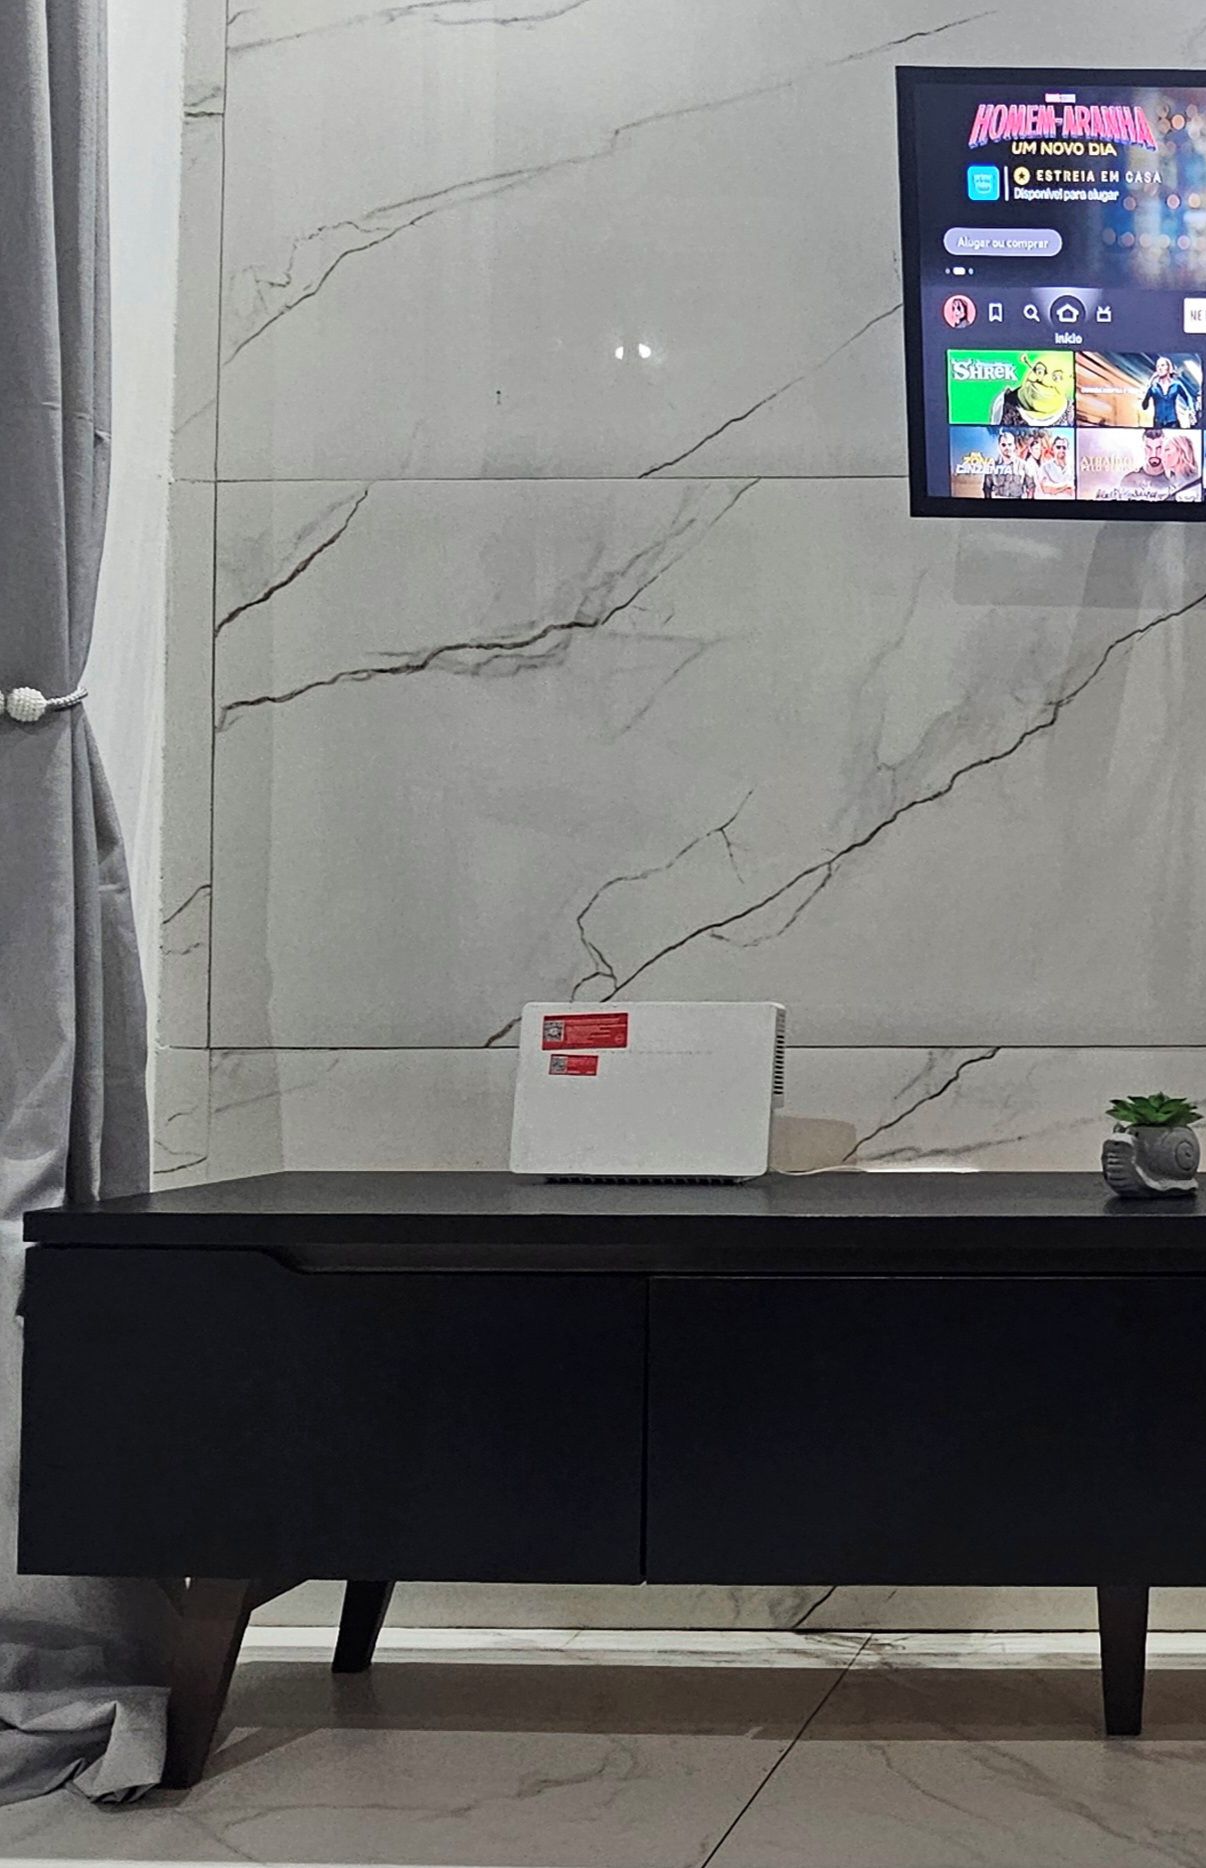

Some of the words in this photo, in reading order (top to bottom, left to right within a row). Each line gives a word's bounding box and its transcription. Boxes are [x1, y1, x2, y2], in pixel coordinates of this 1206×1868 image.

[968, 104, 1158, 151] HOMEM-ARANHA
[1012, 141, 1035, 155] UM
[1041, 142, 1085, 156] NOVO
[1088, 143, 1118, 156] DIA
[1036, 169, 1096, 182] ESTREIA
[1101, 170, 1120, 182] EM
[1125, 170, 1162, 184] CASA
[1013, 187, 1063, 200] Disponível
[1063, 190, 1087, 201] para
[1087, 188, 1120, 202] alugar
[957, 236, 990, 250] Alugar
[991, 239, 1005, 248] ou
[1006, 239, 1050, 251] comprar
[1054, 332, 1083, 345] Início
